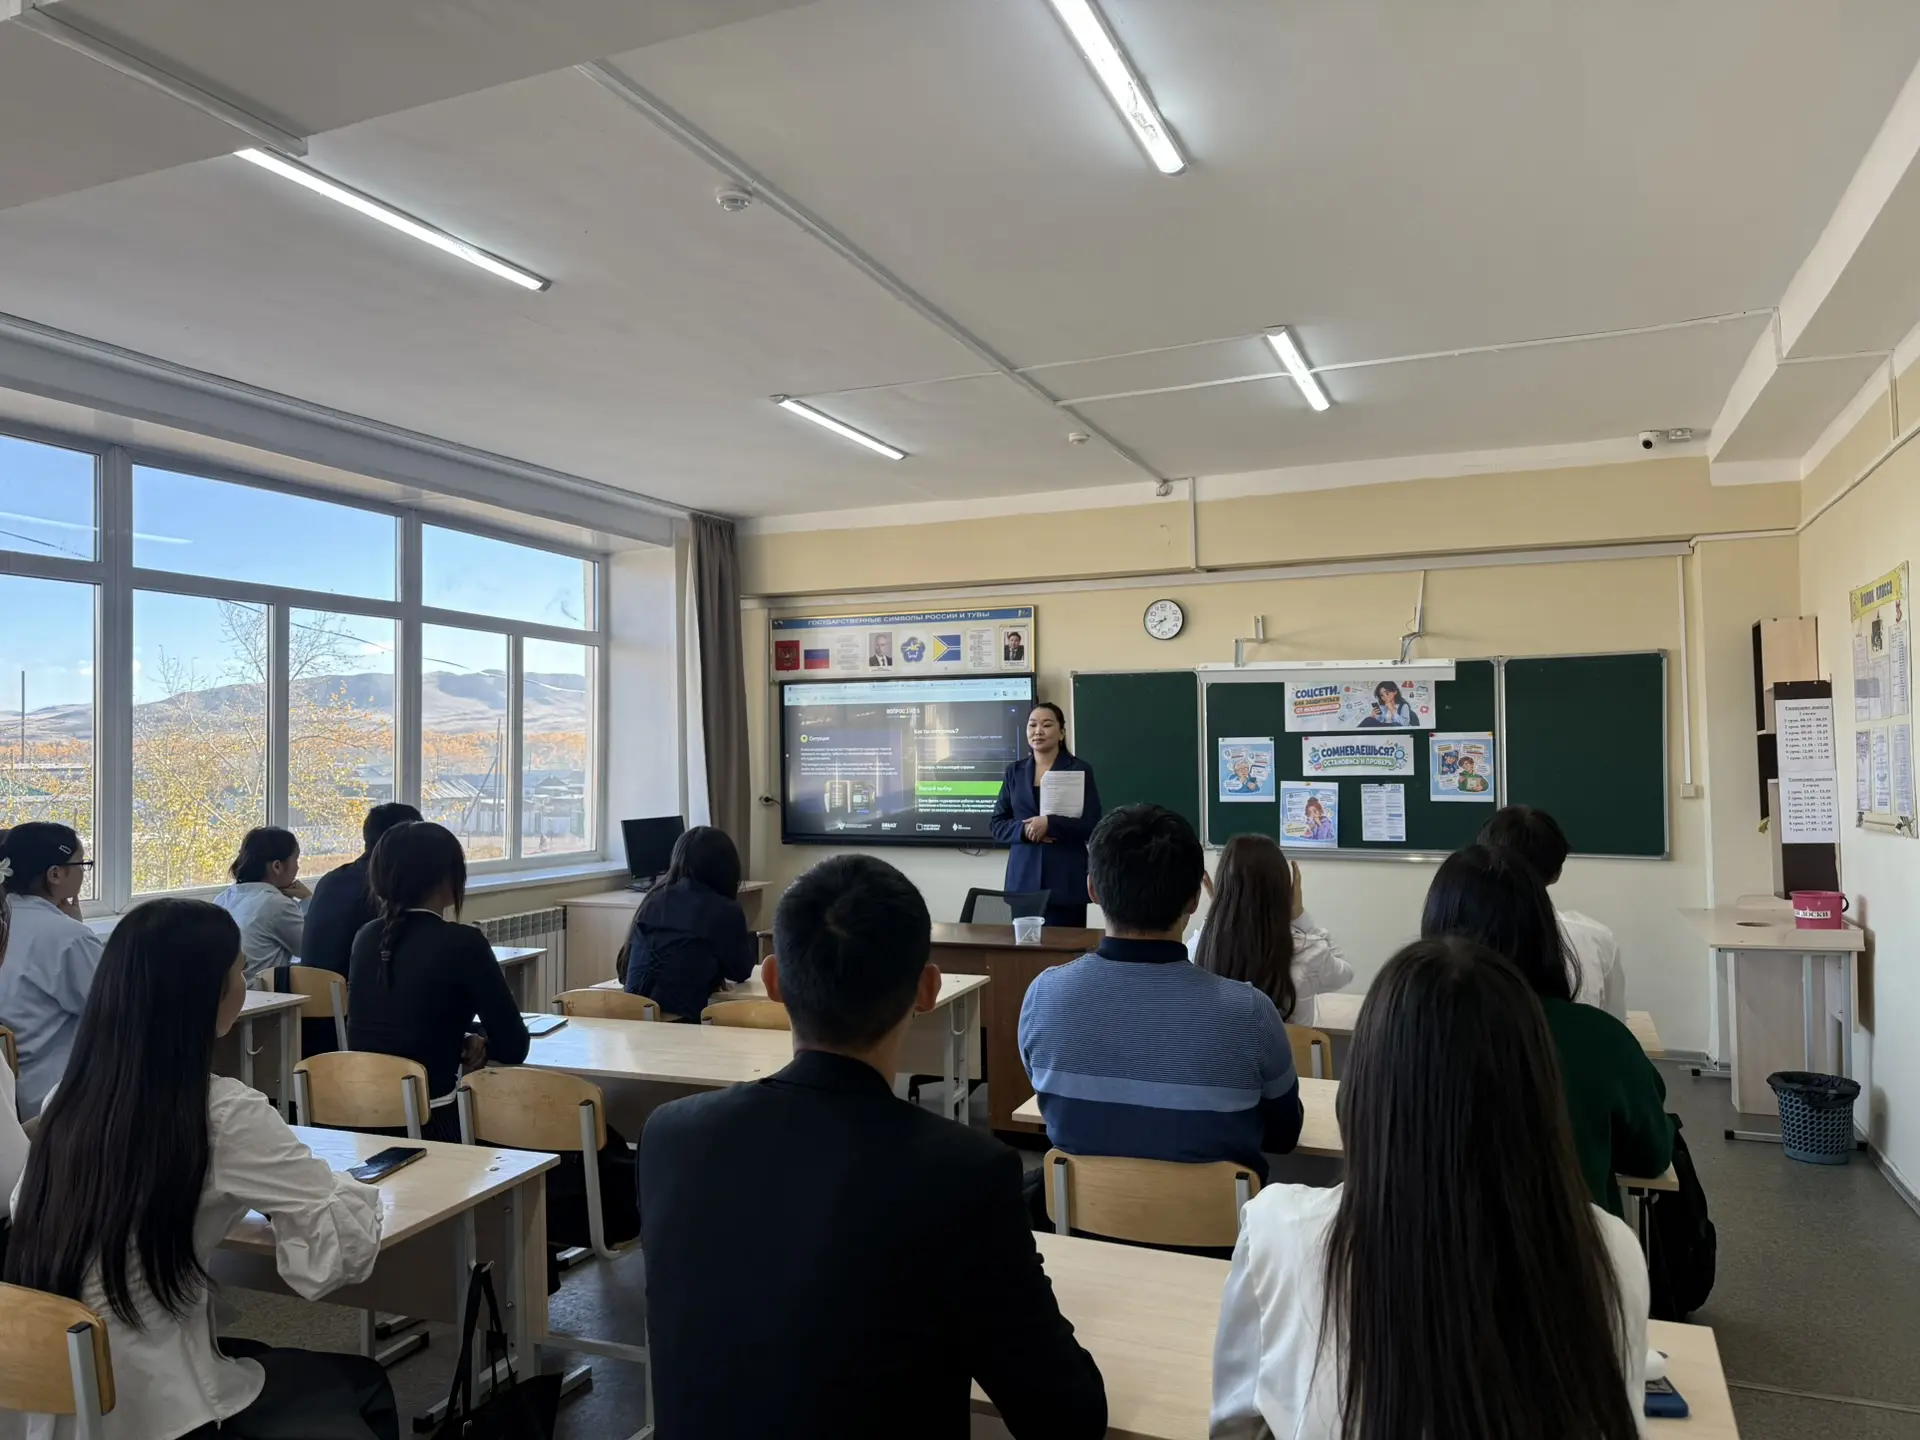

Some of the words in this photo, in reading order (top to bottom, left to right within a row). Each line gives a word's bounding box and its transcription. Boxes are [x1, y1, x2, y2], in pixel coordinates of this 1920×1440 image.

[808, 616, 882, 626] ГОСУДАРСТВЕННЫЕ
[1295, 685, 1341, 699] СОЦСЕТИ.
[1321, 745, 1395, 758] СОМНЕВАЕШЬСЯ?
[1323, 758, 1359, 767] ОСТАНОВИСЬ
